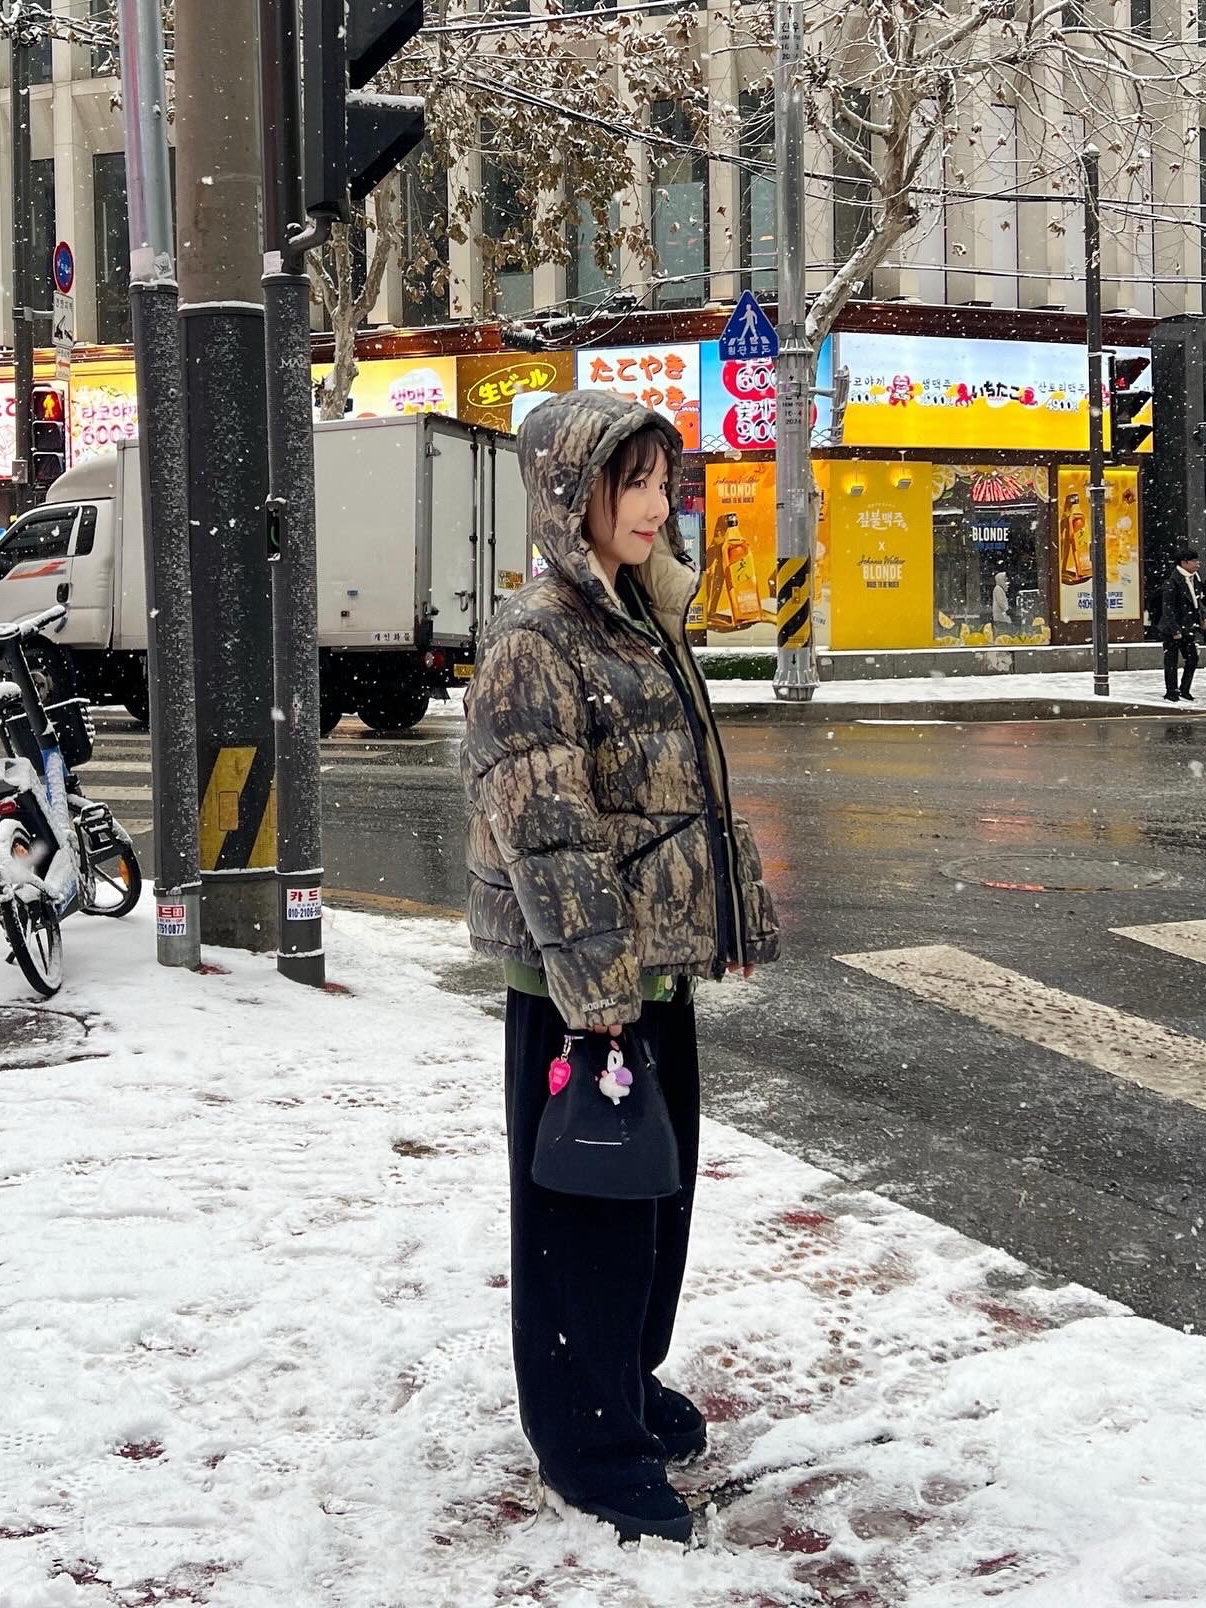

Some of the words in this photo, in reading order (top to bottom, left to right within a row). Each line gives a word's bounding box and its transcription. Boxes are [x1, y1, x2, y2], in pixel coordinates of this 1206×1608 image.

[728, 345, 771, 356] 횡단보도
[479, 368, 549, 405] 生ビール
[972, 381, 1019, 400] いちたこ
[717, 483, 757, 497] BLONDE
[972, 527, 1010, 542] BLONDE
[863, 564, 903, 580] BLONDE
[290, 889, 318, 902] 카드
[601, 998, 616, 1008] FILL
